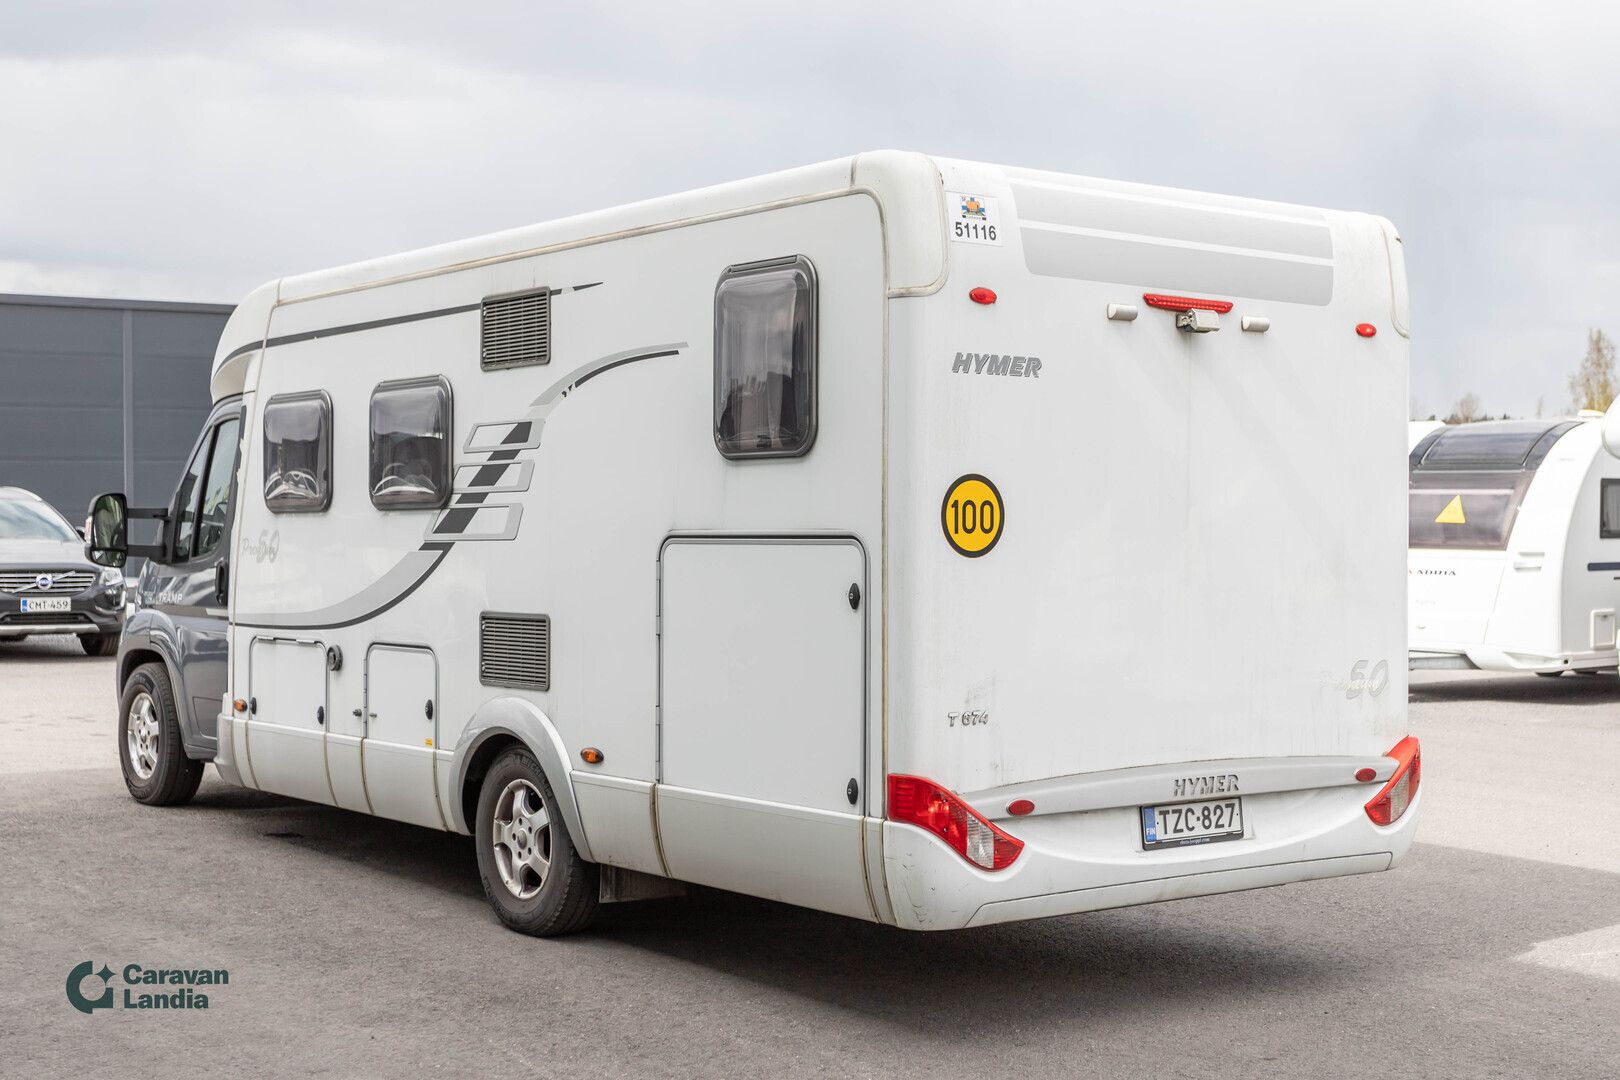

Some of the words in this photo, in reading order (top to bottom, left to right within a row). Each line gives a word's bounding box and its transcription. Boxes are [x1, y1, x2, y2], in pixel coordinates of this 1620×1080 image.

[955, 221, 997, 241] 51116
[952, 352, 1043, 378] HYMER
[951, 499, 995, 535] 100
[1173, 774, 1239, 797] HYMER
[1159, 802, 1236, 835] TZC-827
[1146, 827, 1156, 835] FIN
